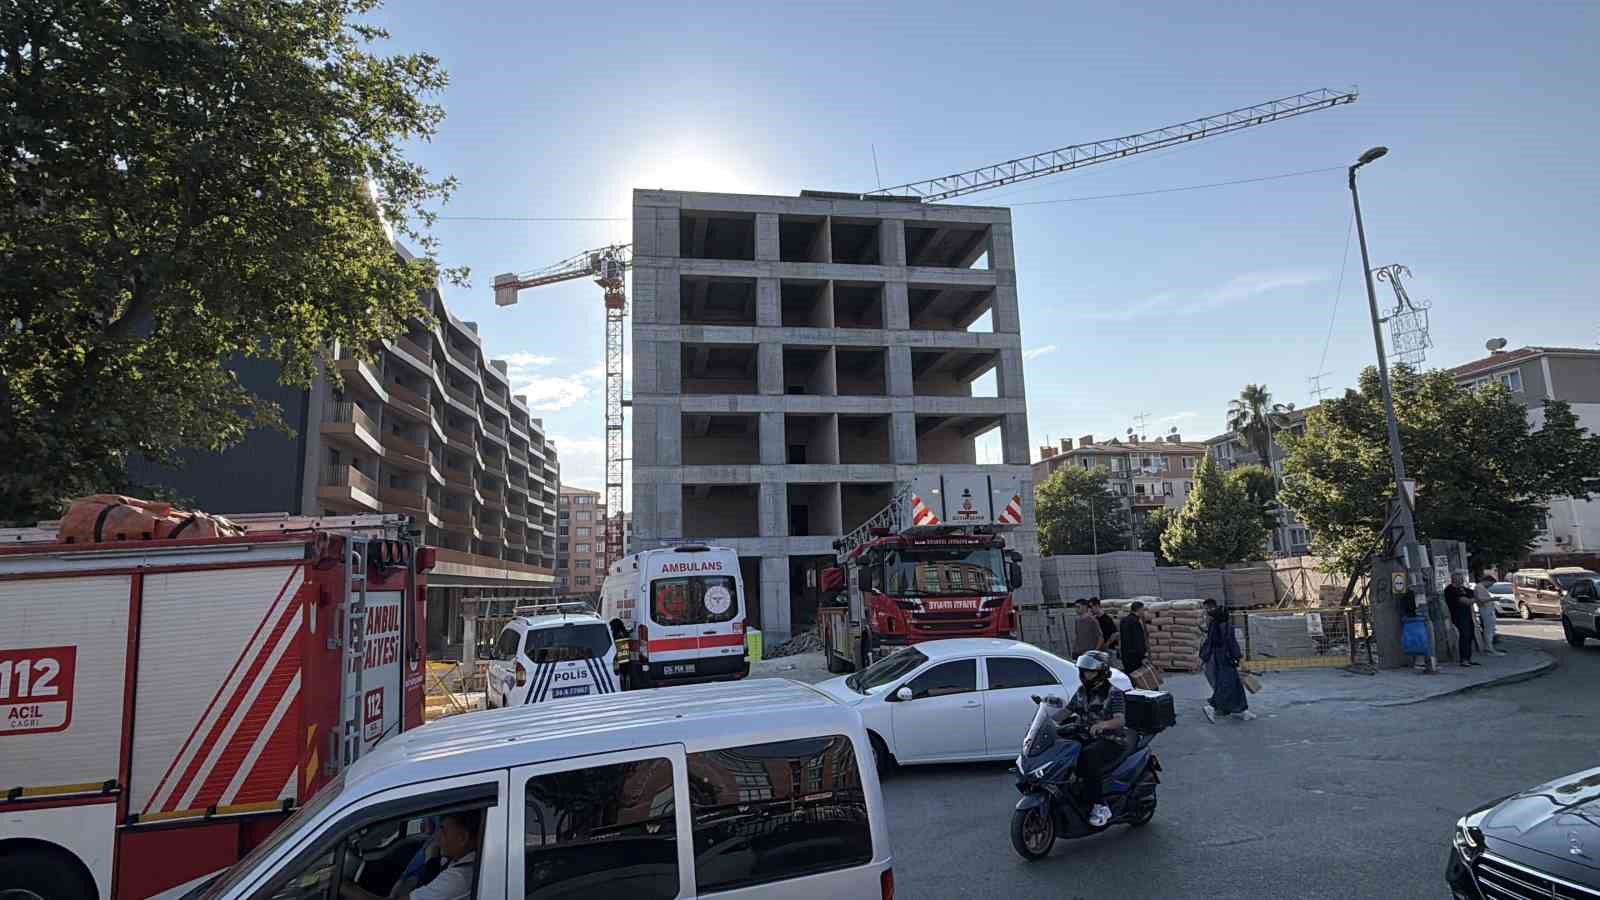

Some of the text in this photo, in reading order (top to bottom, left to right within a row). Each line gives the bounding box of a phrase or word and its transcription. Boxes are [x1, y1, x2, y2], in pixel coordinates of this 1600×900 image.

[662, 561, 722, 573] AMBULANS
[0, 657, 60, 699] 112
[554, 669, 588, 682] POLİS
[367, 692, 381, 719] 112
